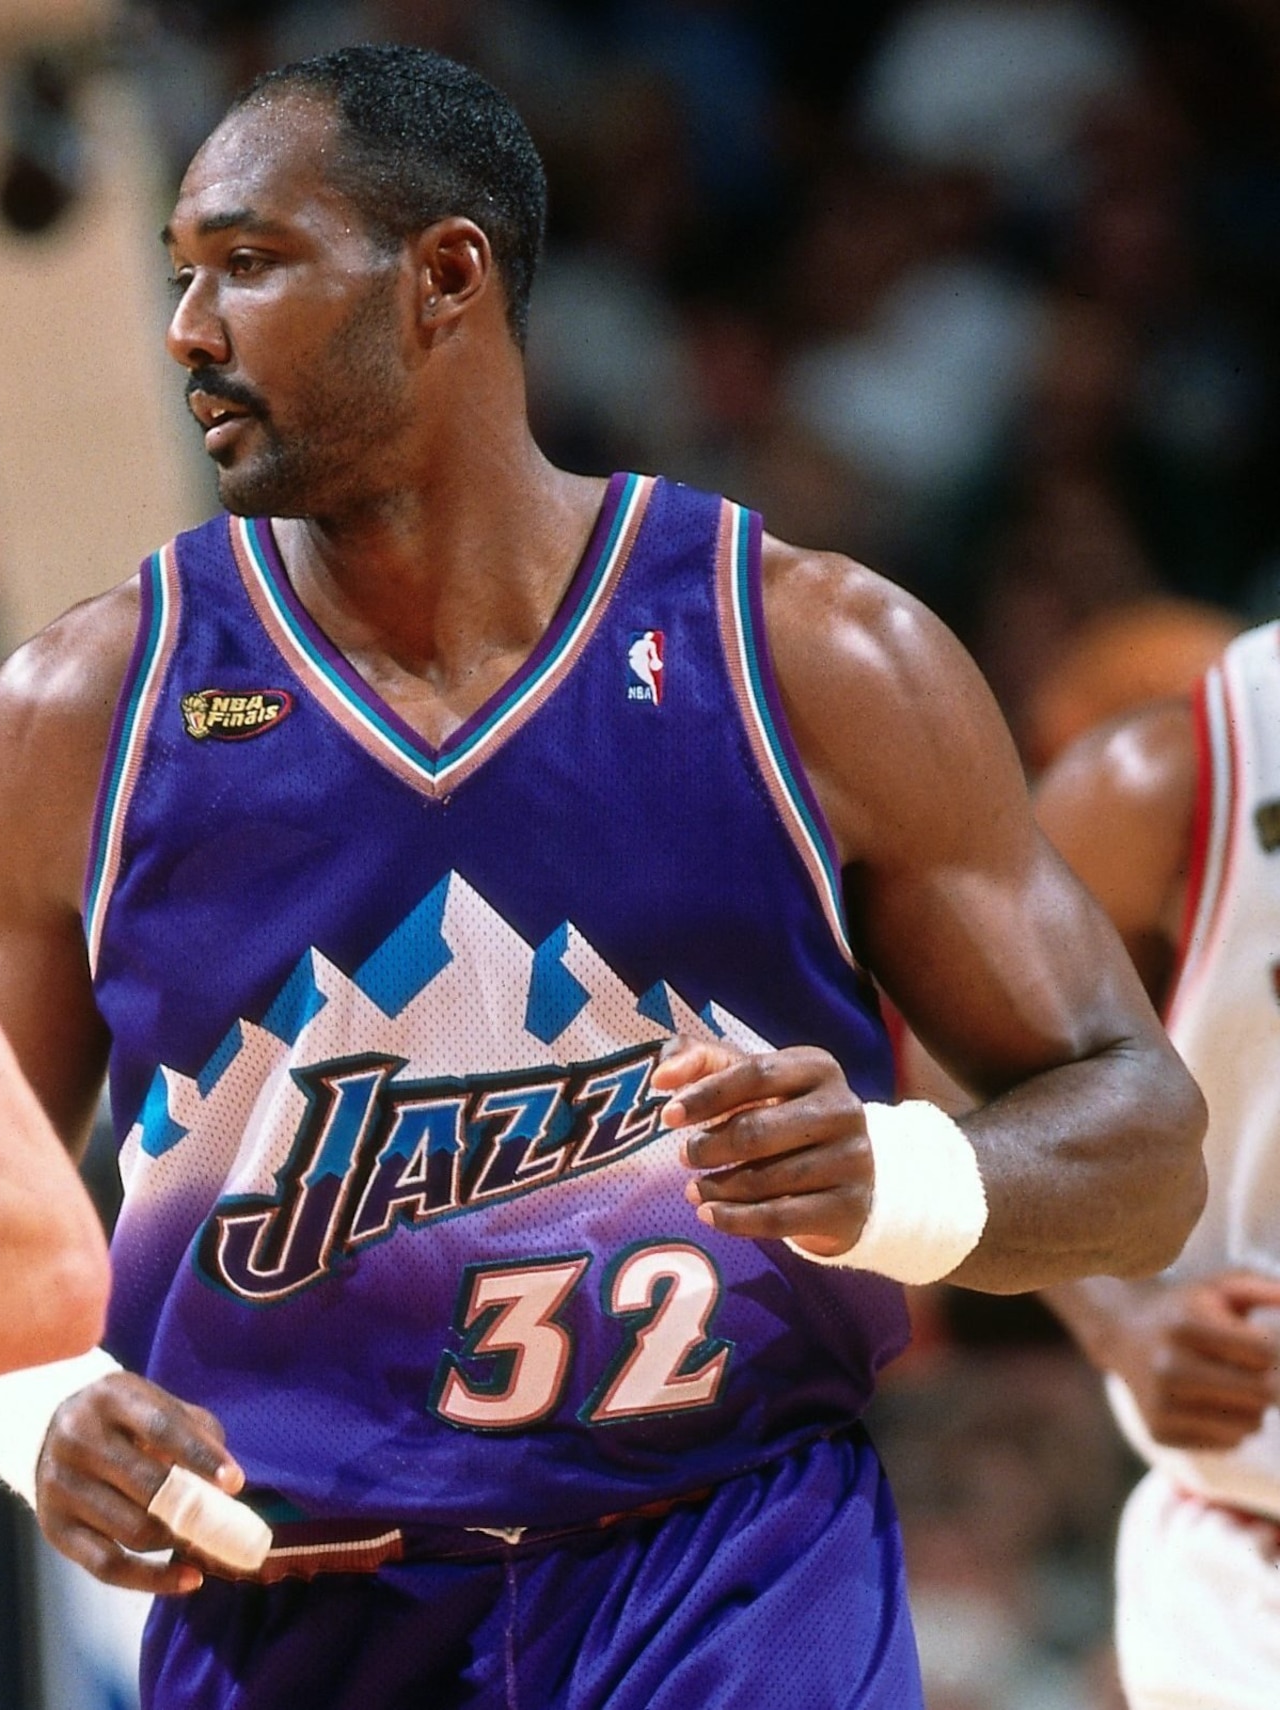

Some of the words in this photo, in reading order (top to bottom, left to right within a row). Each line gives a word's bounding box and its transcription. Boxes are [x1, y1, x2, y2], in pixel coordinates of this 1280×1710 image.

[211, 694, 264, 712] NBA
[627, 685, 652, 700] NBA
[206, 704, 280, 728] Finals
[425, 1235, 737, 1435] 32
